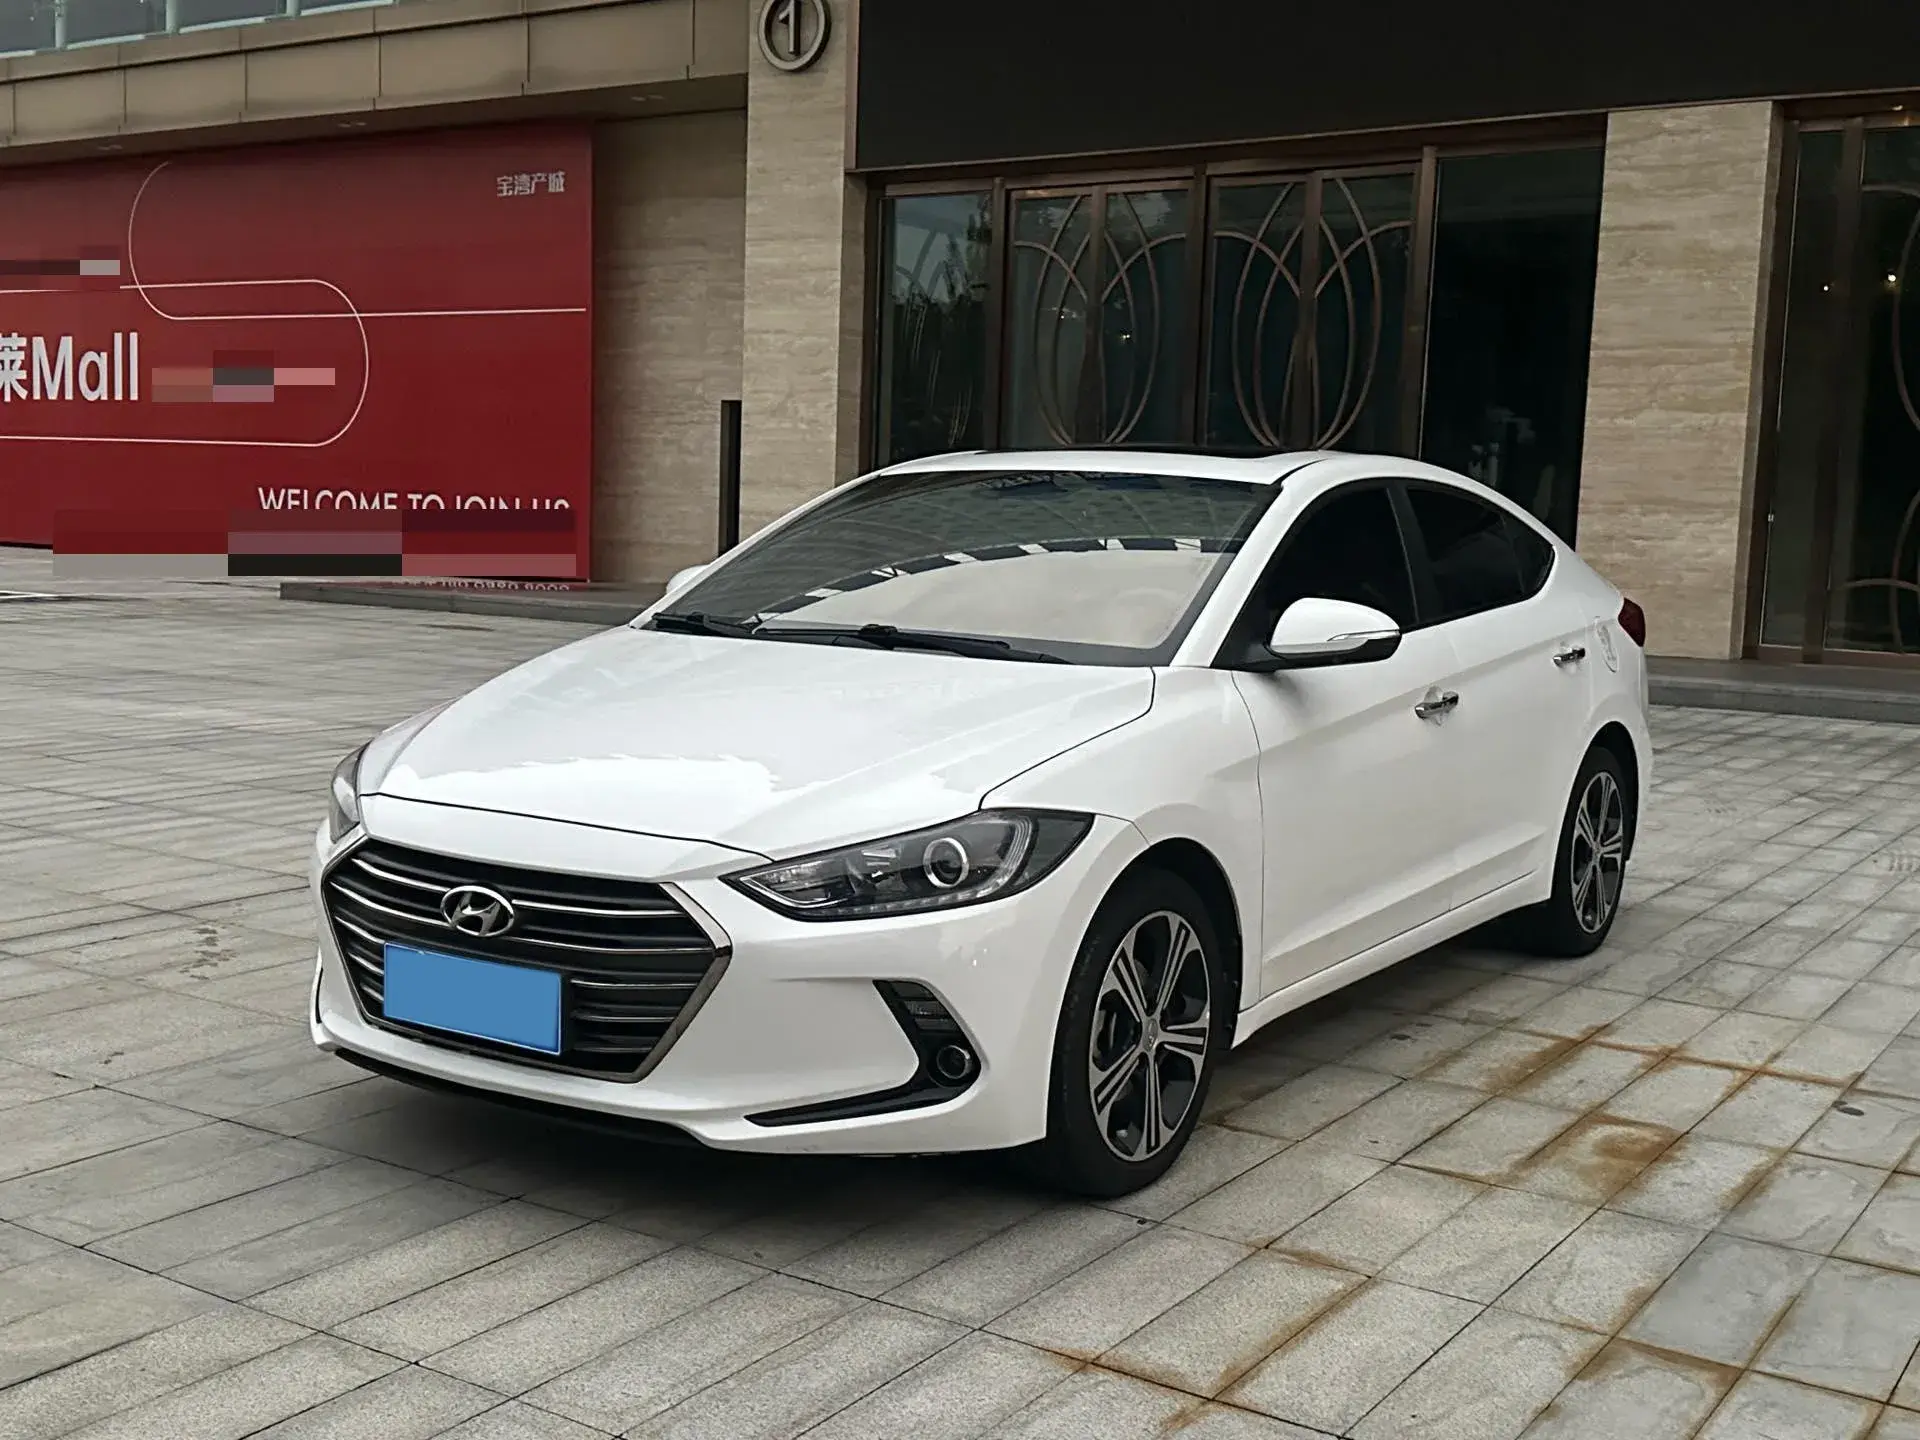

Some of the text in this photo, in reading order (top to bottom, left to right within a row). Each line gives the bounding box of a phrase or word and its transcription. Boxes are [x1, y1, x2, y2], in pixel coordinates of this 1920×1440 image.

[778, 0, 797, 53] 1
[497, 170, 566, 196] 宝湾产城
